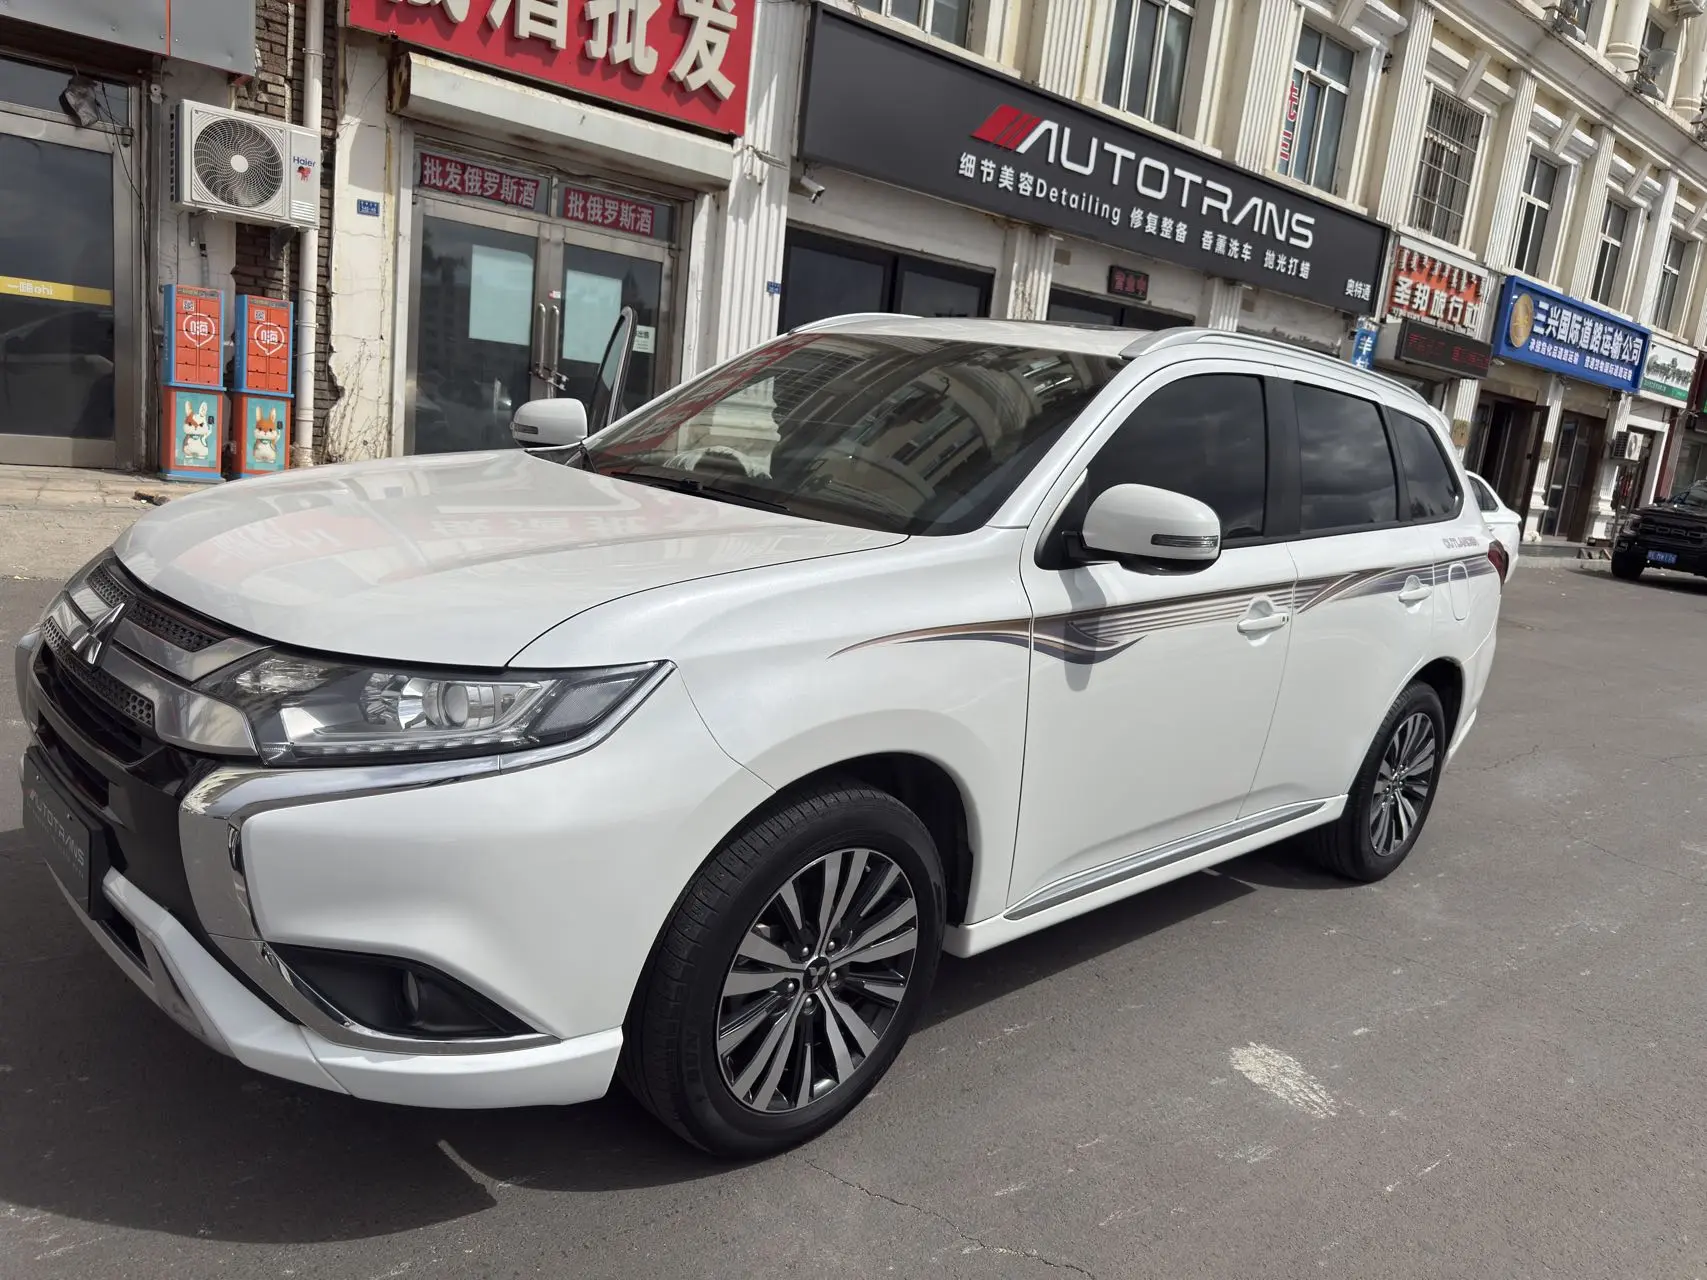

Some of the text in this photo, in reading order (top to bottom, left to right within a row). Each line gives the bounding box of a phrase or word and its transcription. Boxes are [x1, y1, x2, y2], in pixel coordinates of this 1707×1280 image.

[292, 156, 316, 167] Haier
[423, 156, 537, 208] 批发俄罗斯酒
[1016, 119, 1316, 249] AUTOTRANS
[567, 191, 653, 236] 批俄罗斯酒
[1130, 206, 1188, 243] 修复整备
[1201, 230, 1253, 262] 香薰洗车
[1345, 279, 1372, 302] 奥特通
[1532, 300, 1644, 366] 三兴国际道路运输公司
